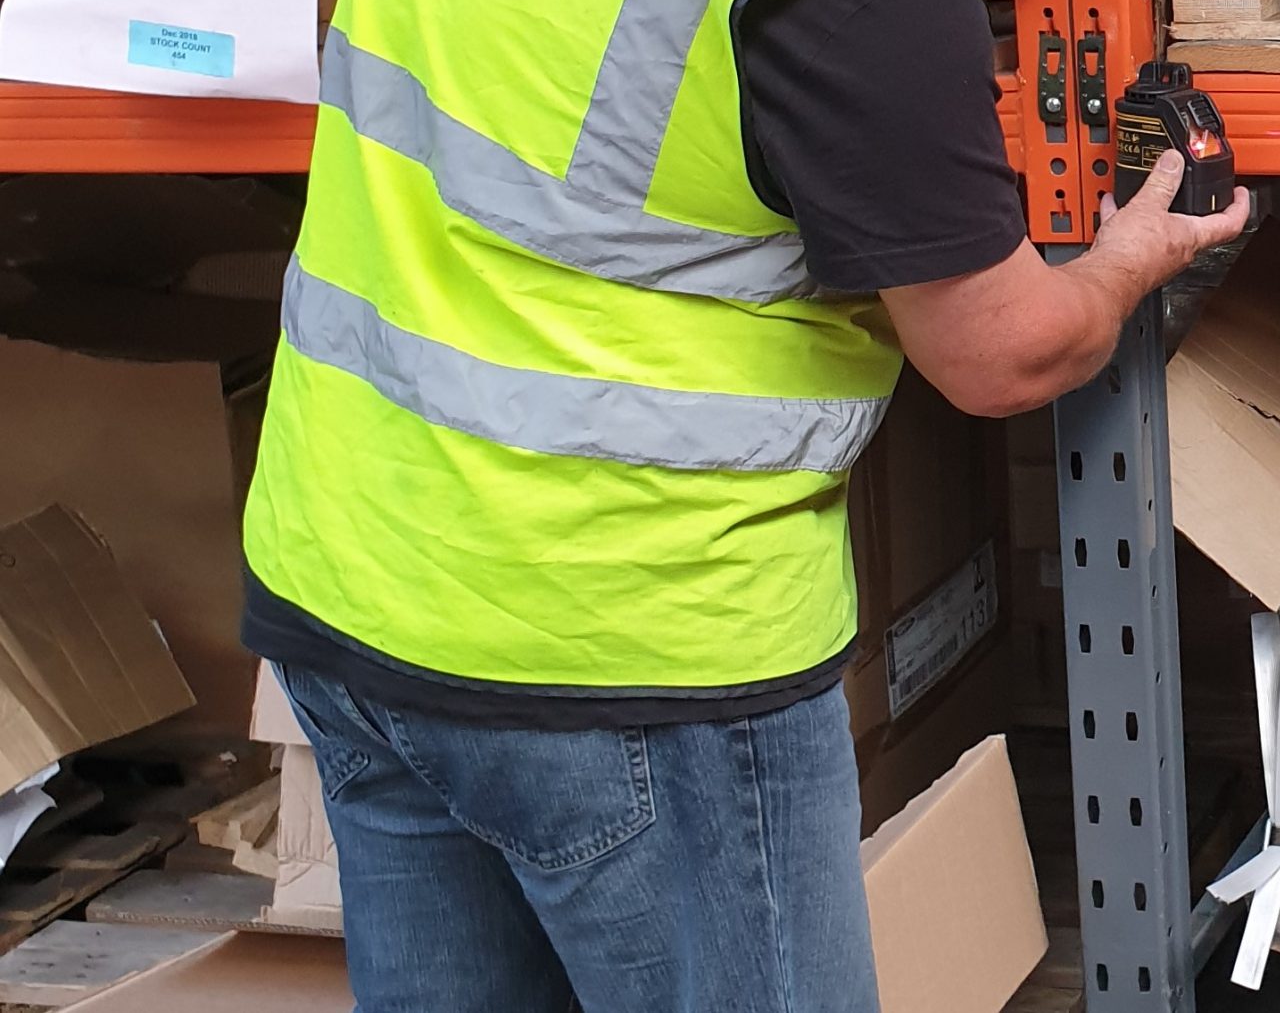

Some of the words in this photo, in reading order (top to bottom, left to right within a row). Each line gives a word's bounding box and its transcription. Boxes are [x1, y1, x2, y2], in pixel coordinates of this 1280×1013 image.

[161, 28, 178, 38] Dec
[150, 37, 180, 48] STOCK
[181, 41, 212, 53] COUNT
